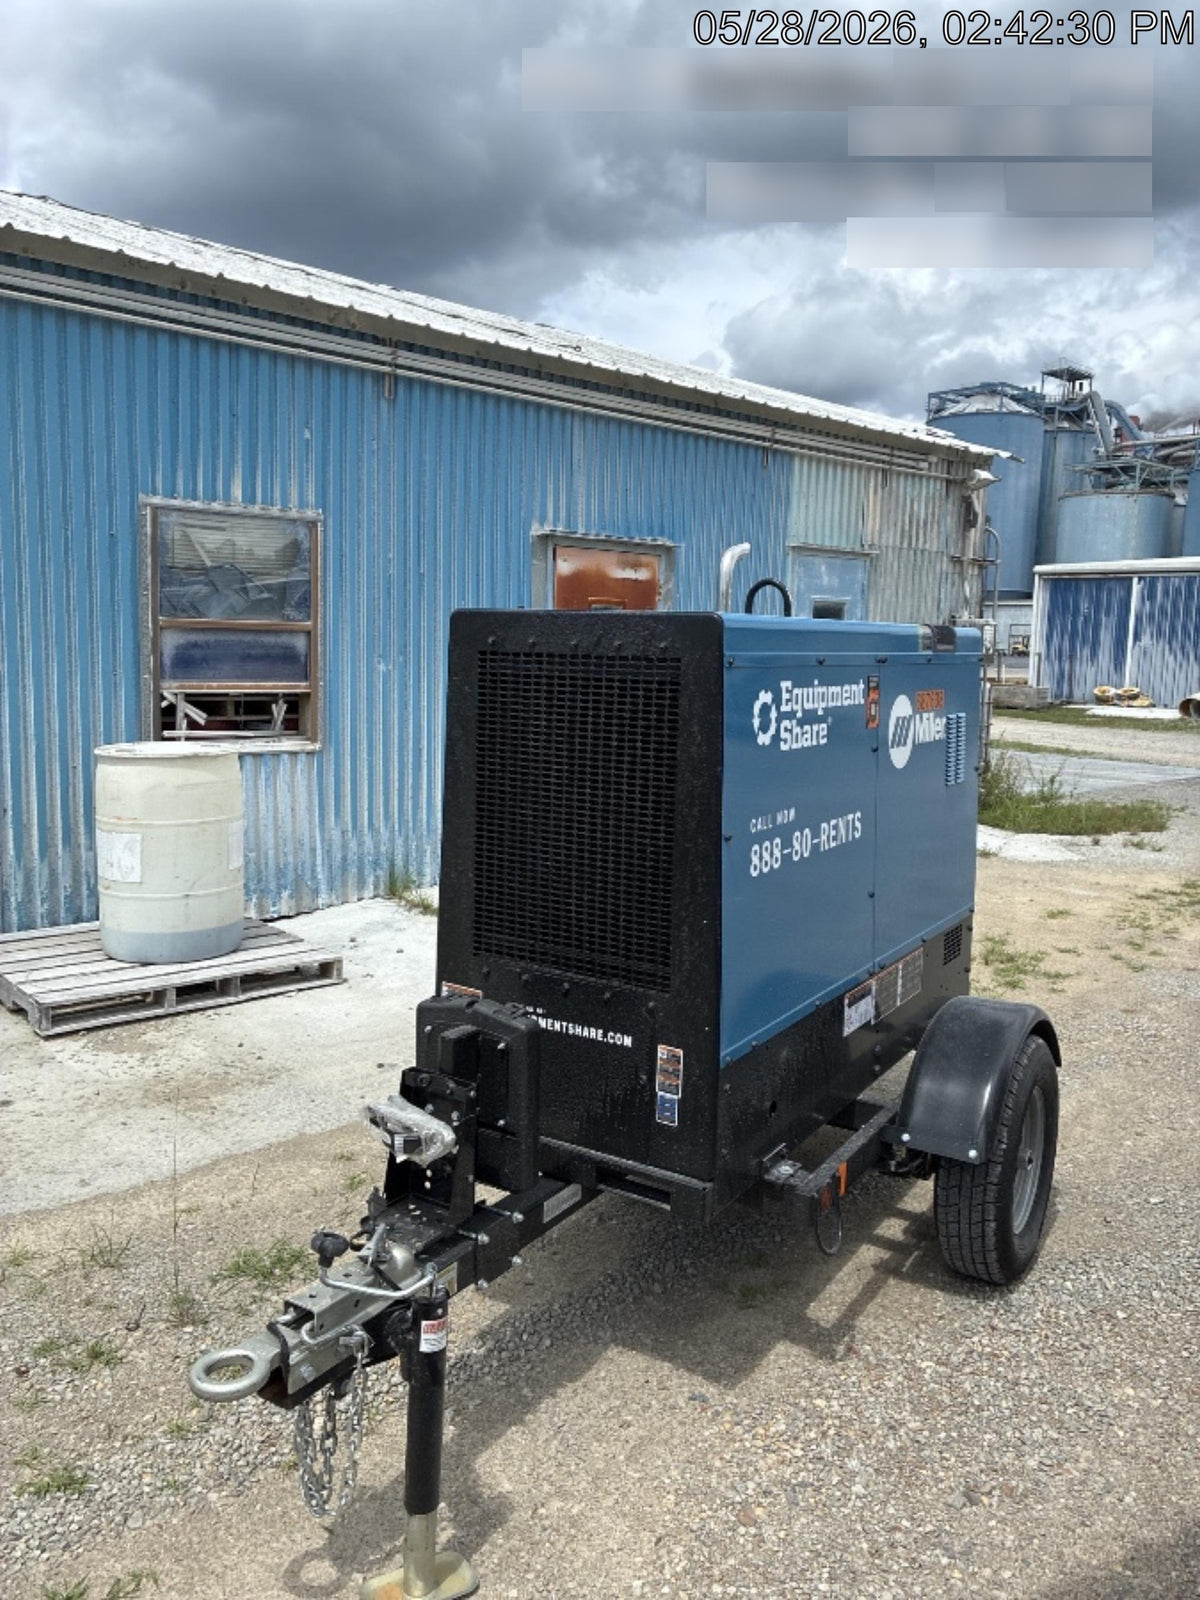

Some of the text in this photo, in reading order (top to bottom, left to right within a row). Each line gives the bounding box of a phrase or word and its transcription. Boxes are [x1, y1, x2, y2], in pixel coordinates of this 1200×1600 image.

[780, 679, 865, 718] Equipment
[780, 719, 828, 751] Share
[750, 806, 796, 834] CALL NOW
[750, 810, 862, 877] 888-80-RENTS
[527, 1013, 633, 1048] MENTSHARE.COM
